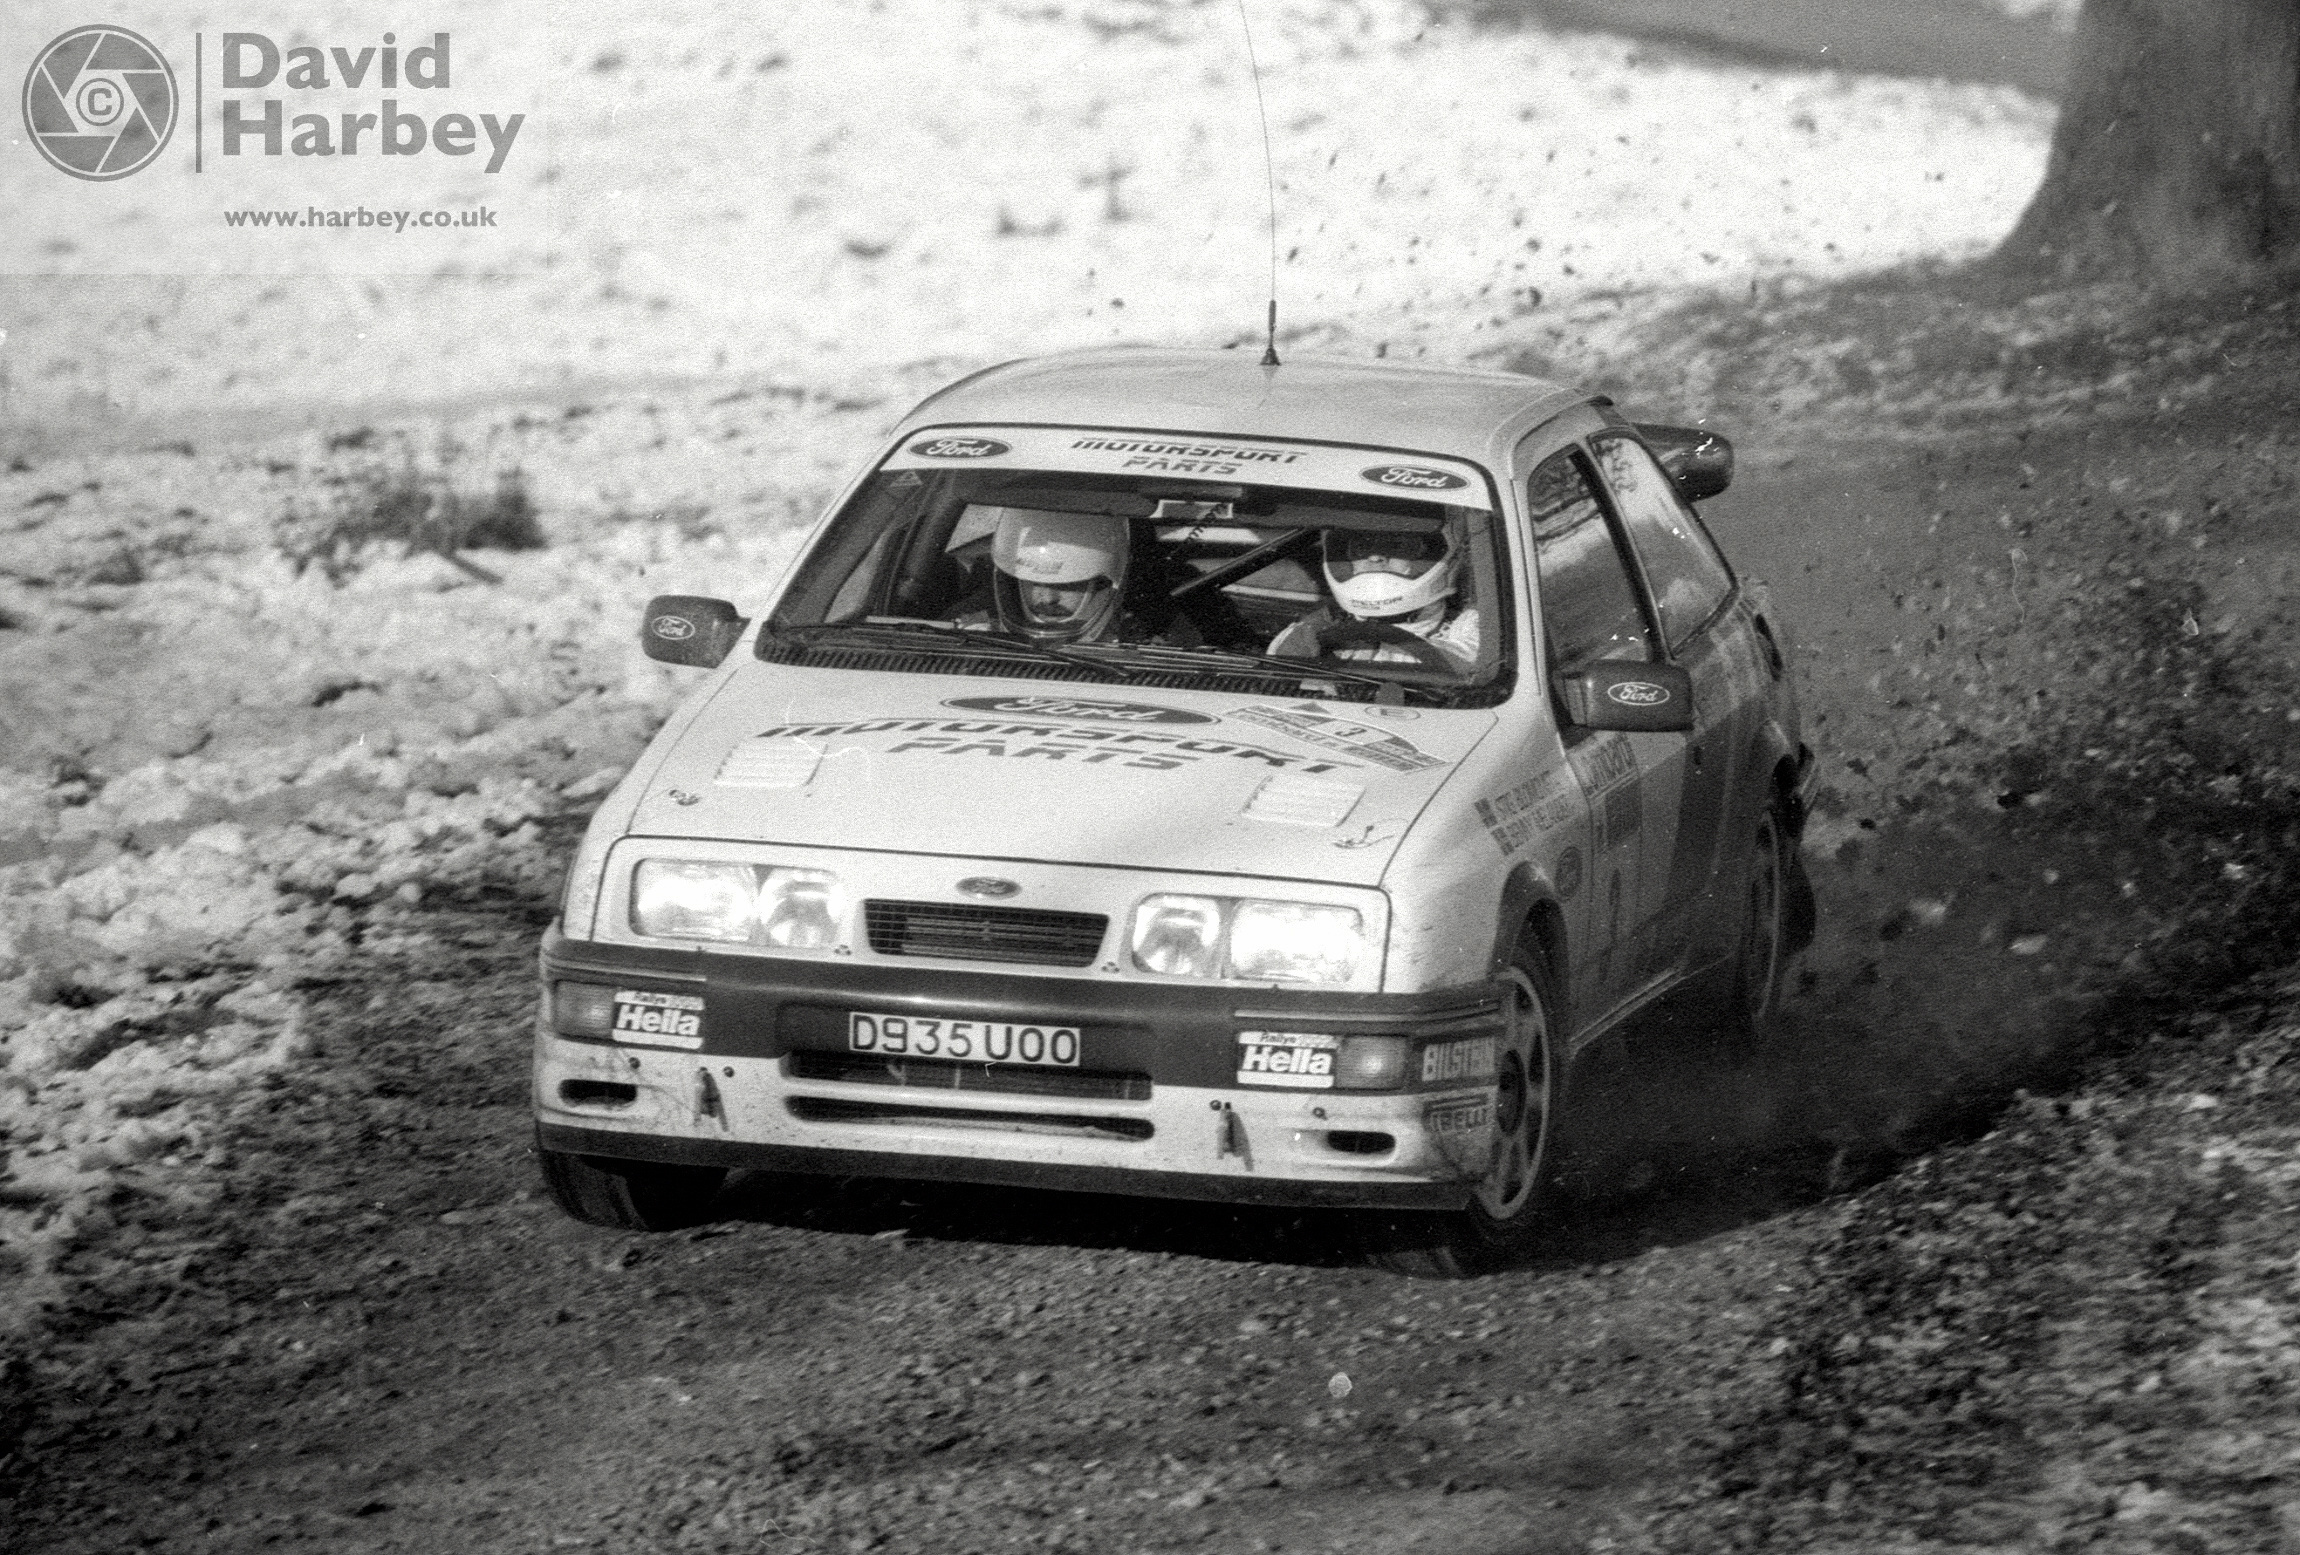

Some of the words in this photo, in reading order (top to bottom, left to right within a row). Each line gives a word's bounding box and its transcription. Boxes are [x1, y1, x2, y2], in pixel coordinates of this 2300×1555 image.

[926, 439, 993, 457] Ford
[1070, 436, 1308, 464] MOTORSPORT
[1121, 455, 1244, 475] PARTS
[1381, 466, 1449, 488] Ford
[658, 617, 687, 637] Ford
[1619, 684, 1659, 702] Ford
[993, 697, 1167, 721] Ford
[754, 717, 1365, 774] MOTORSPORT
[884, 736, 1201, 771] PARTS
[616, 1003, 701, 1036] Hella
[1241, 1044, 1334, 1075] Hella
